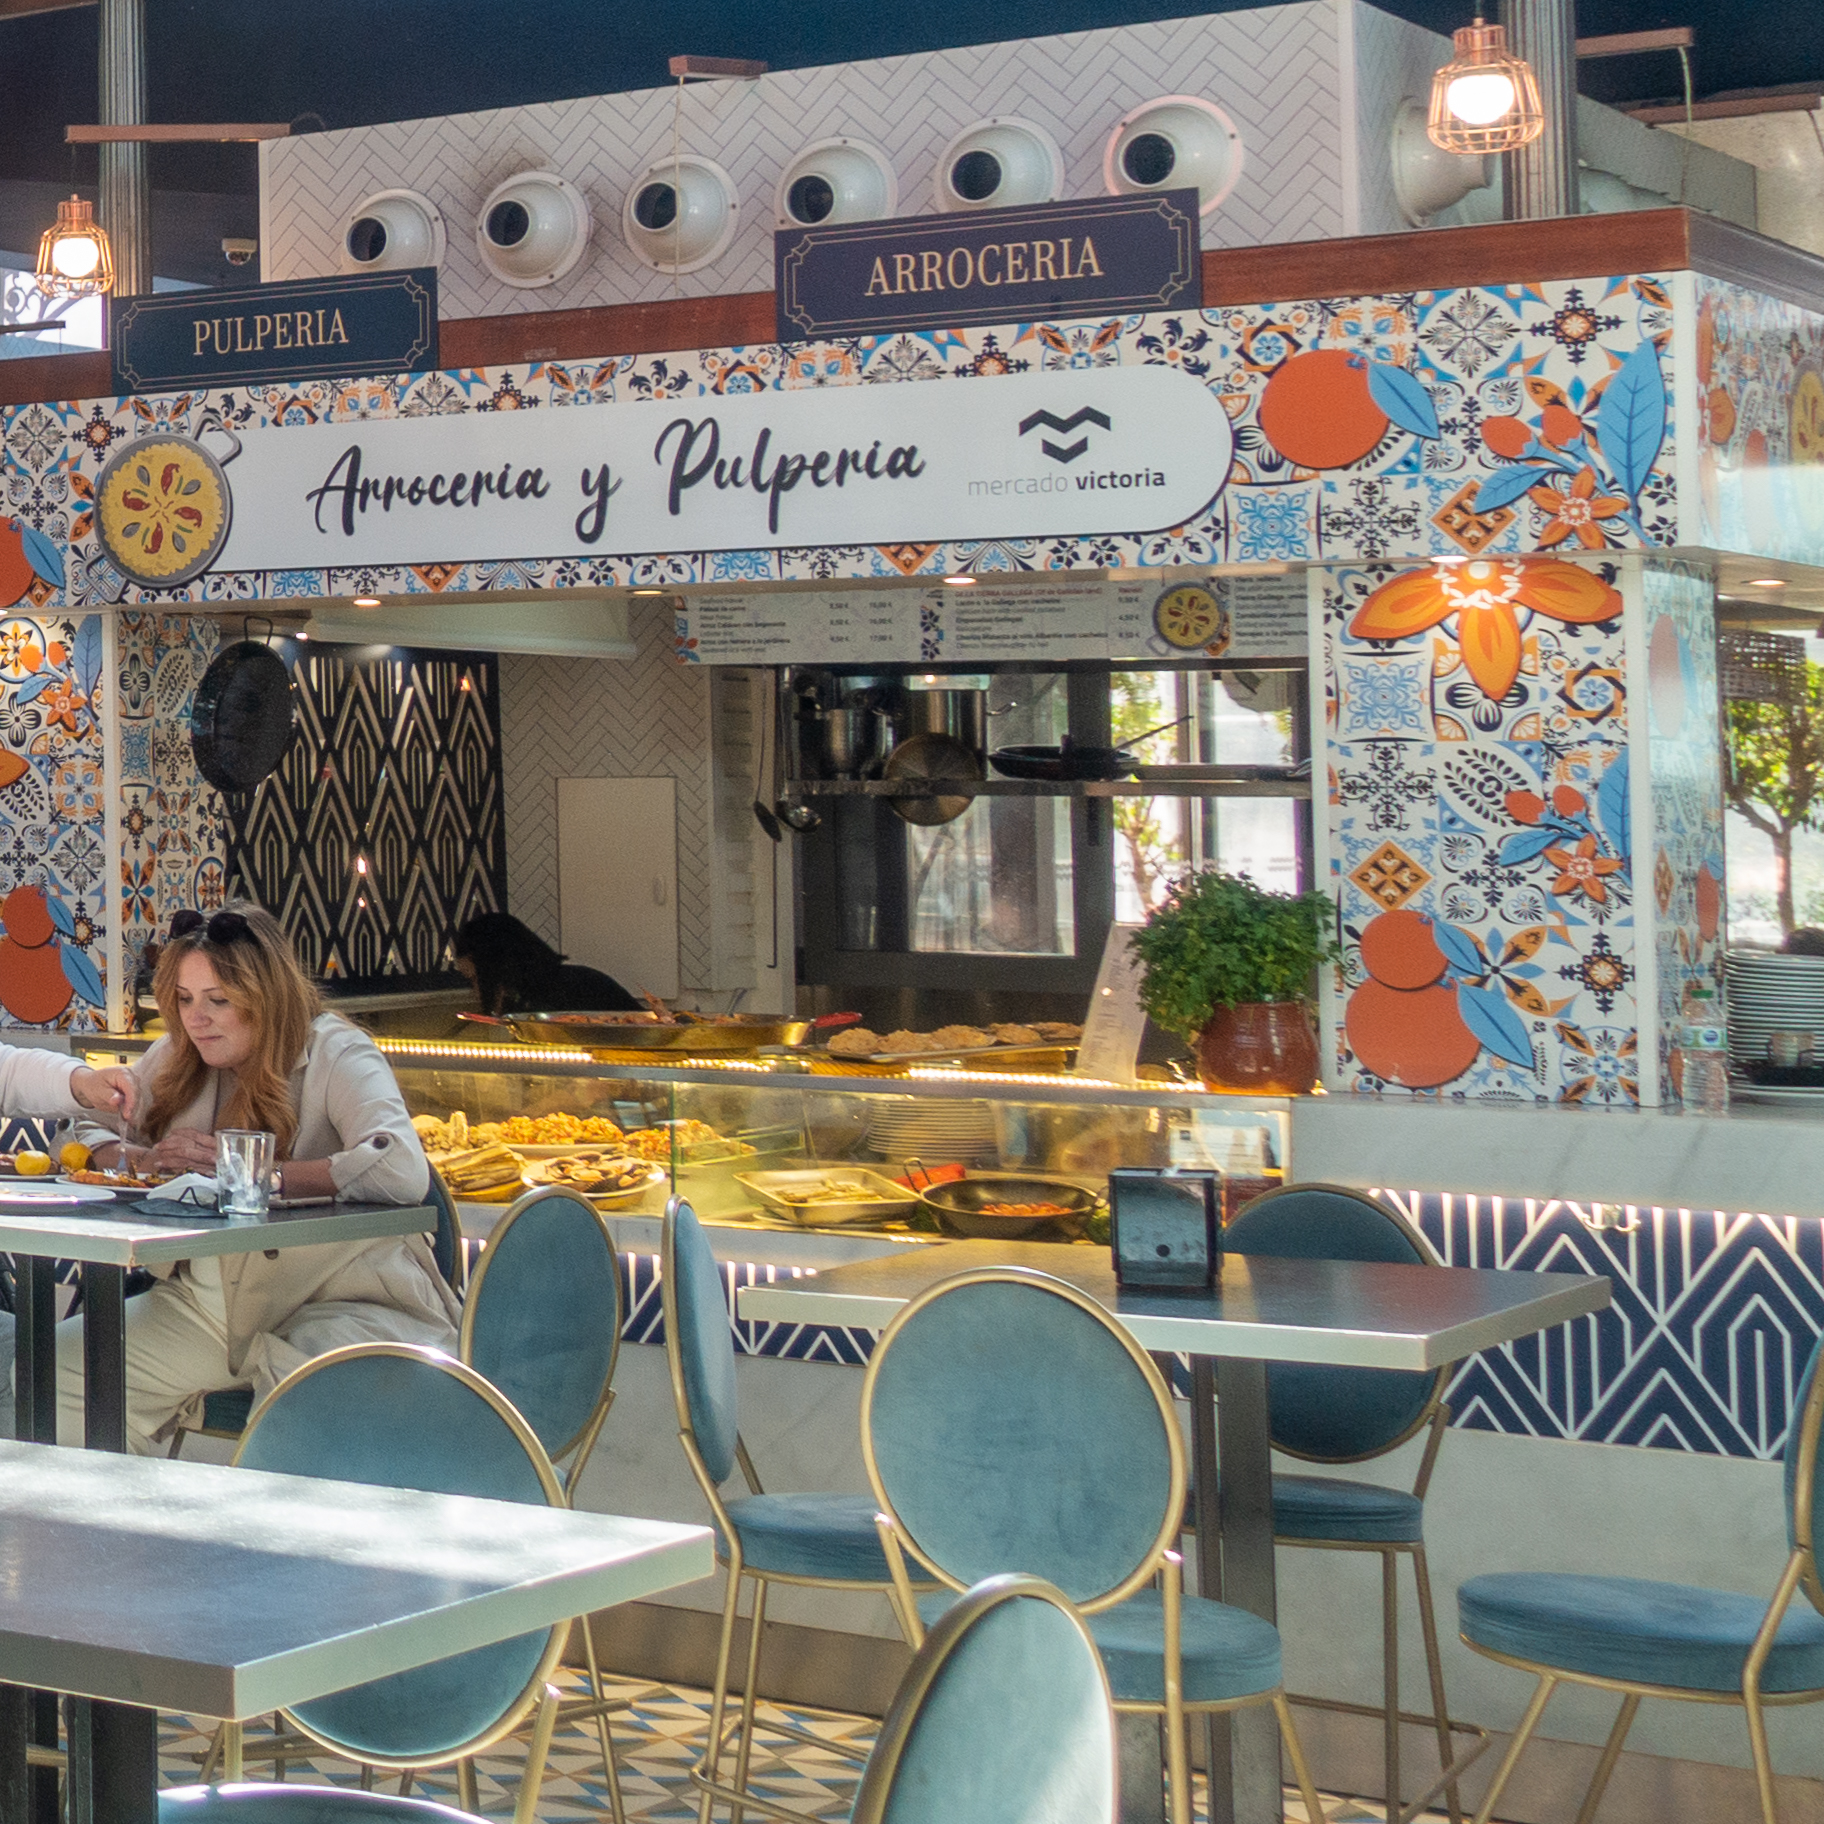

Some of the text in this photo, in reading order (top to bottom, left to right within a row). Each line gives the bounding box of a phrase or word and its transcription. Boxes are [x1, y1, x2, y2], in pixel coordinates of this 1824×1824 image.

[864, 236, 1104, 297] ARROCERIA
[193, 308, 349, 356] PULPERIA
[305, 416, 927, 544] Arroceria y Pulperia
[968, 468, 1166, 496] mercado victoria
